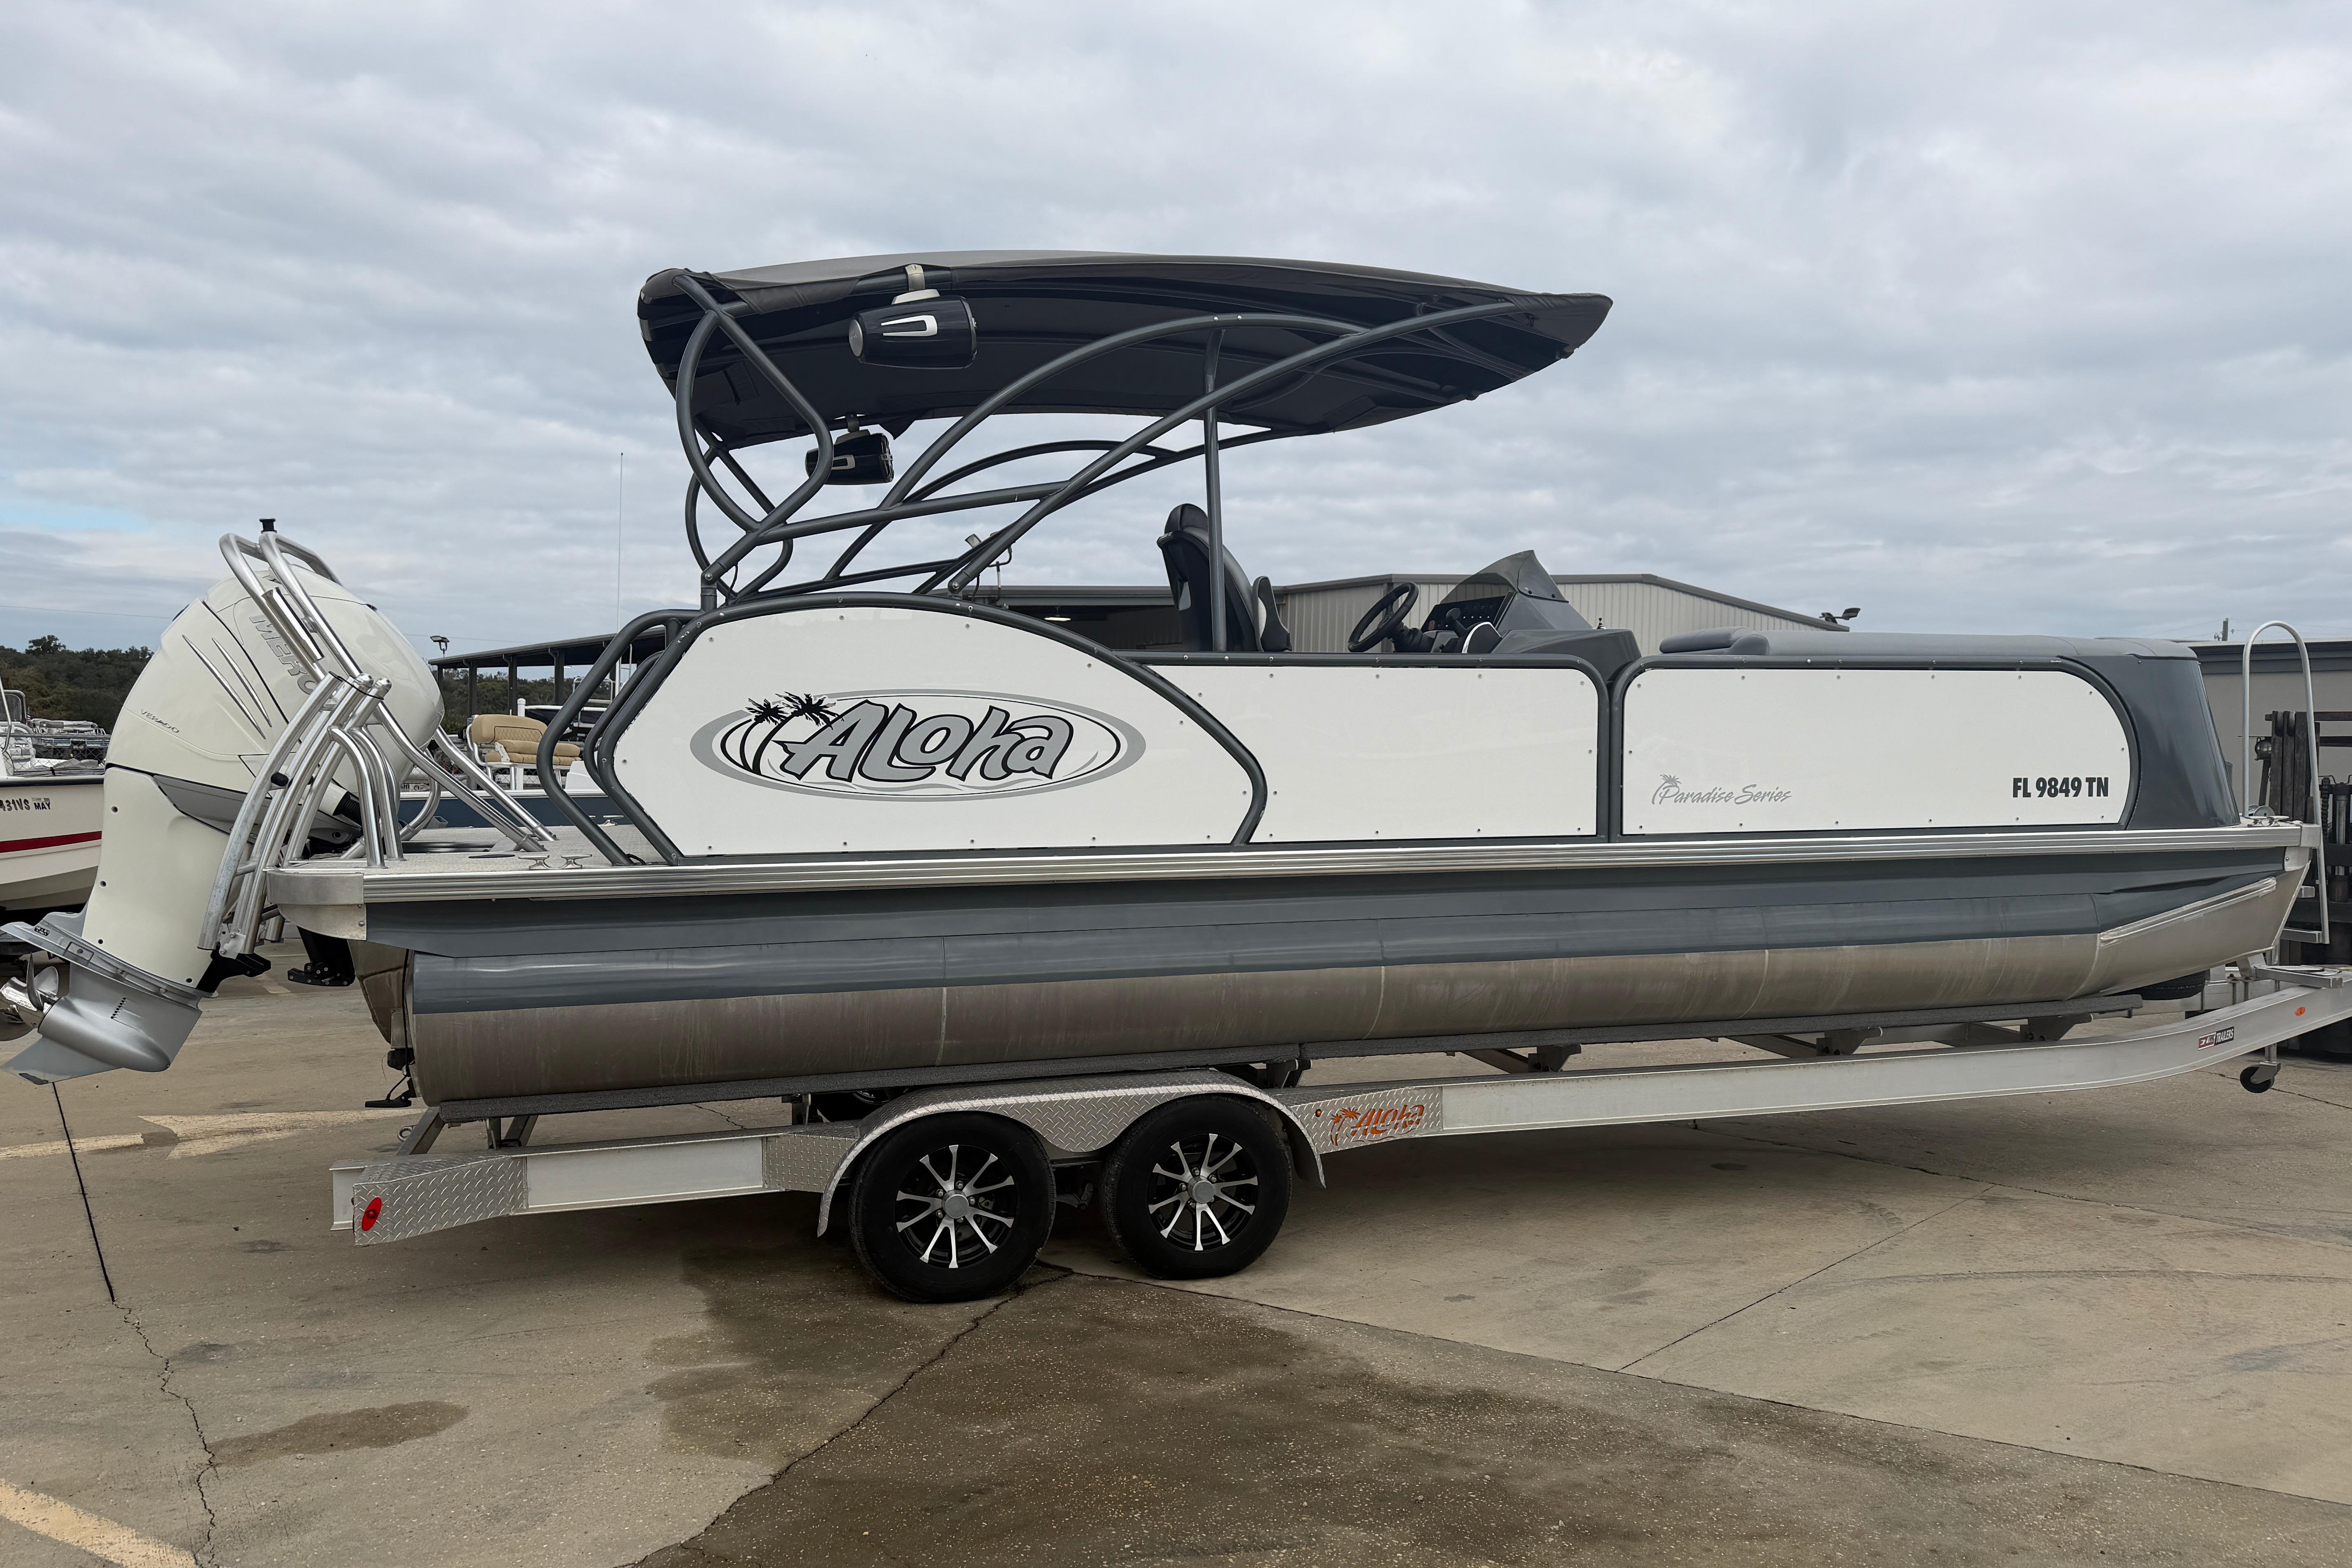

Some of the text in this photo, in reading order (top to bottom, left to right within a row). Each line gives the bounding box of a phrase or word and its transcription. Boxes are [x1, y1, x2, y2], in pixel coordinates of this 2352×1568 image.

[141, 709, 180, 733] VERADO
[1659, 784, 1792, 805] Paradise Series
[2013, 777, 2109, 798] FL 9849 TN
[2216, 1029, 2234, 1043] TRAILERS
